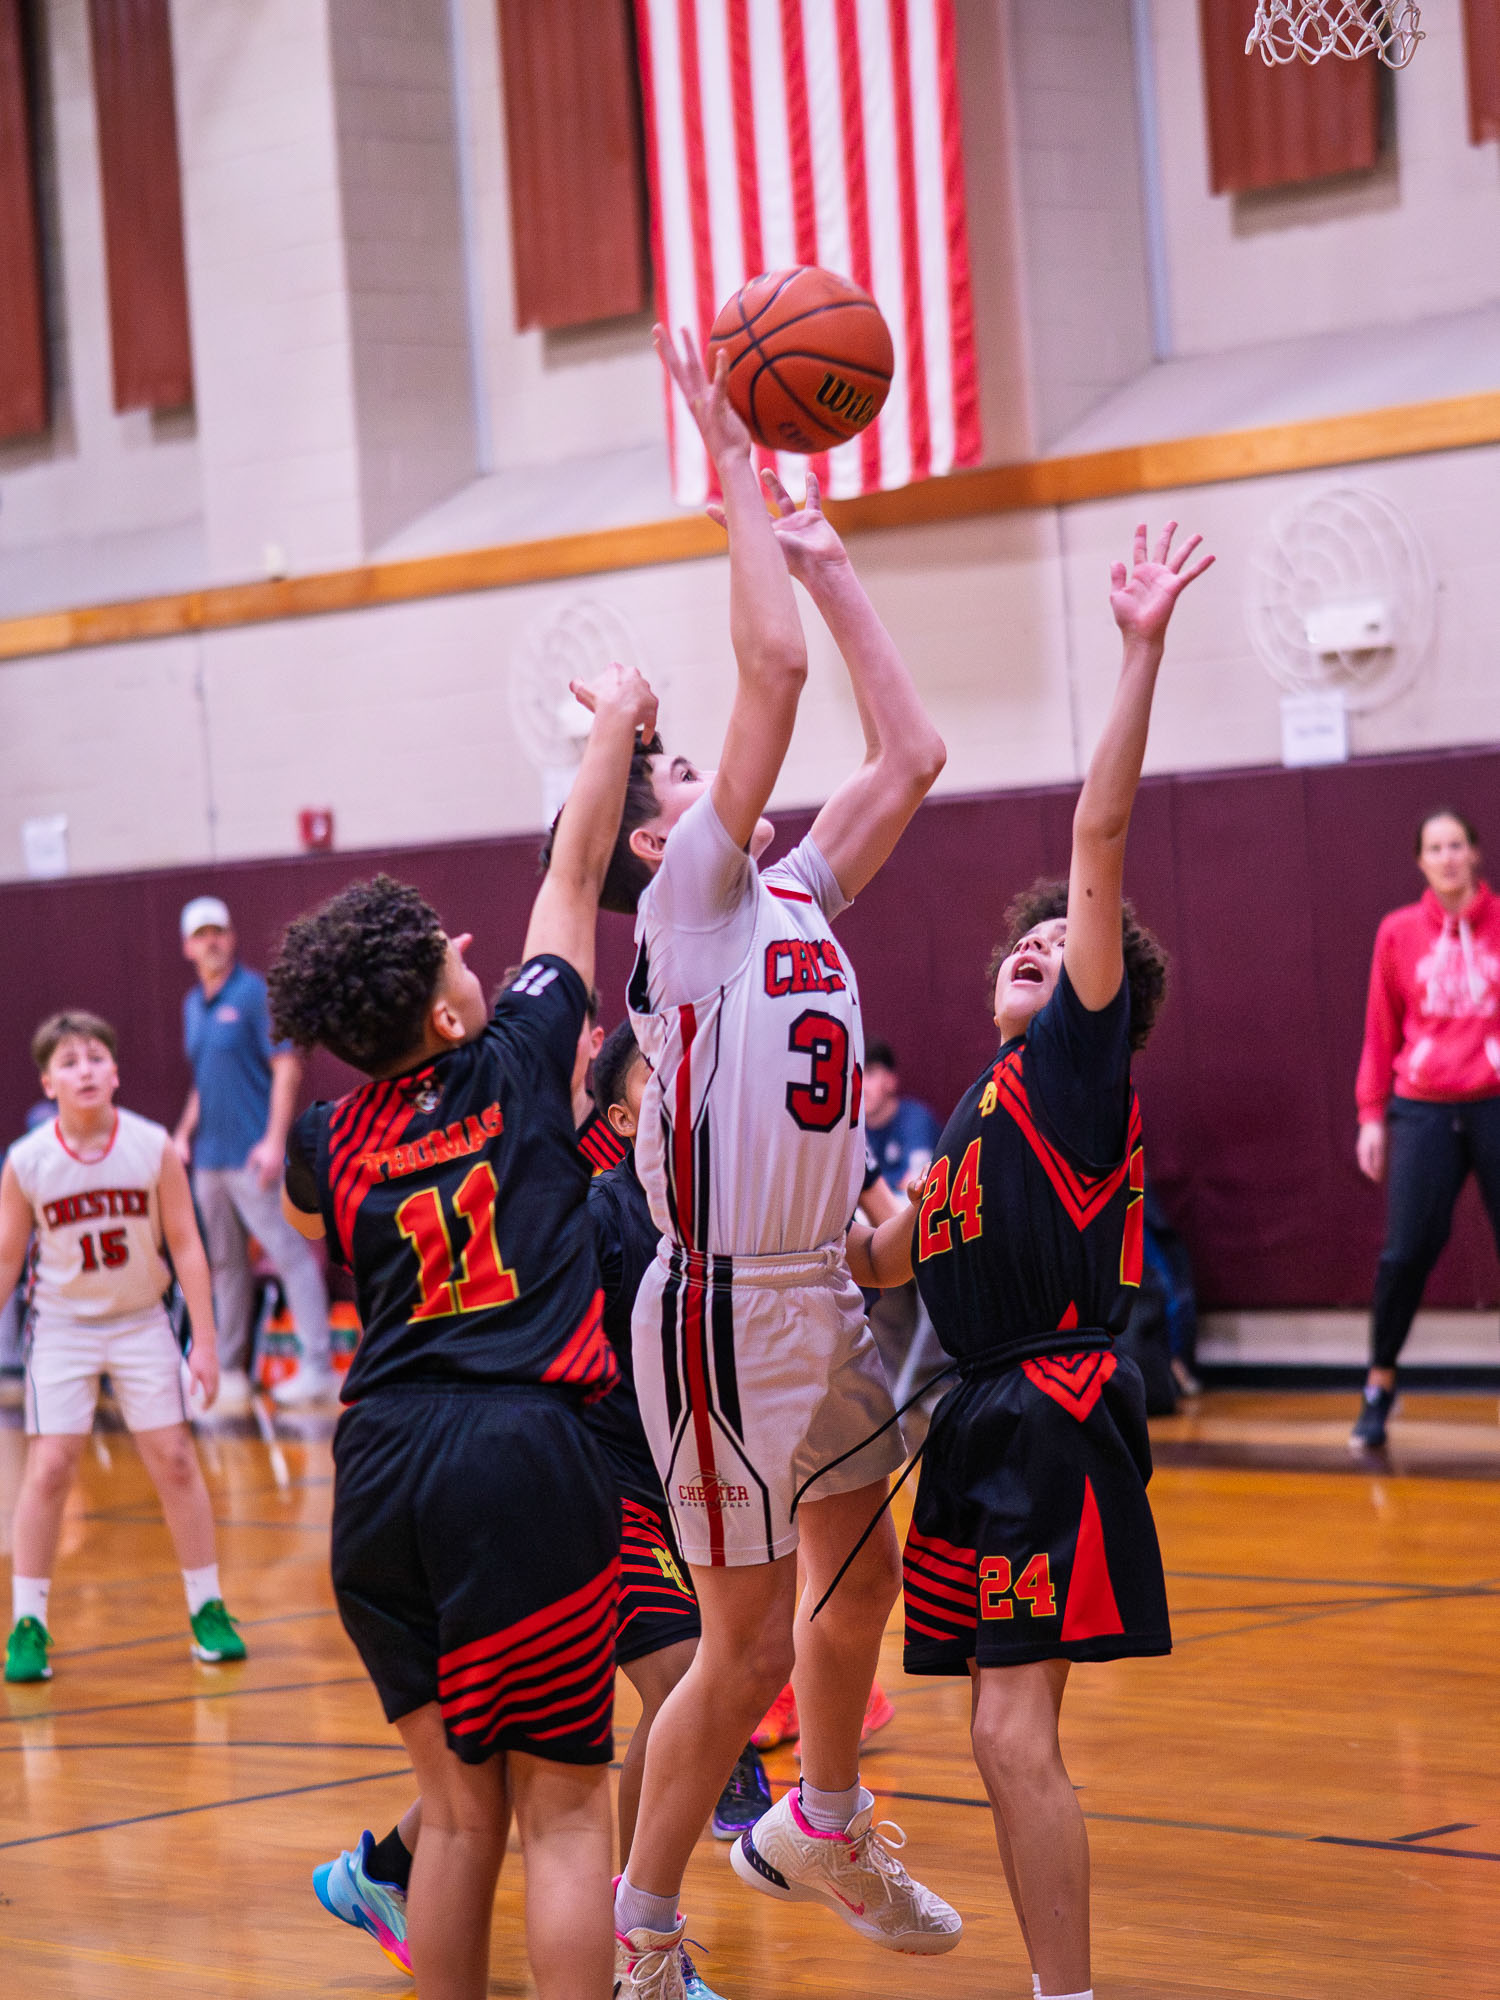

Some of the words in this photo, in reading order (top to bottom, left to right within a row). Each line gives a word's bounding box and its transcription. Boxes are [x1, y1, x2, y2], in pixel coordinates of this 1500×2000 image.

[42, 1187, 149, 1233] CHESTER
[919, 1136, 982, 1263] 24
[80, 1227, 129, 1273] 15
[395, 1160, 520, 1325] 11
[979, 1552, 1057, 1620] 24
